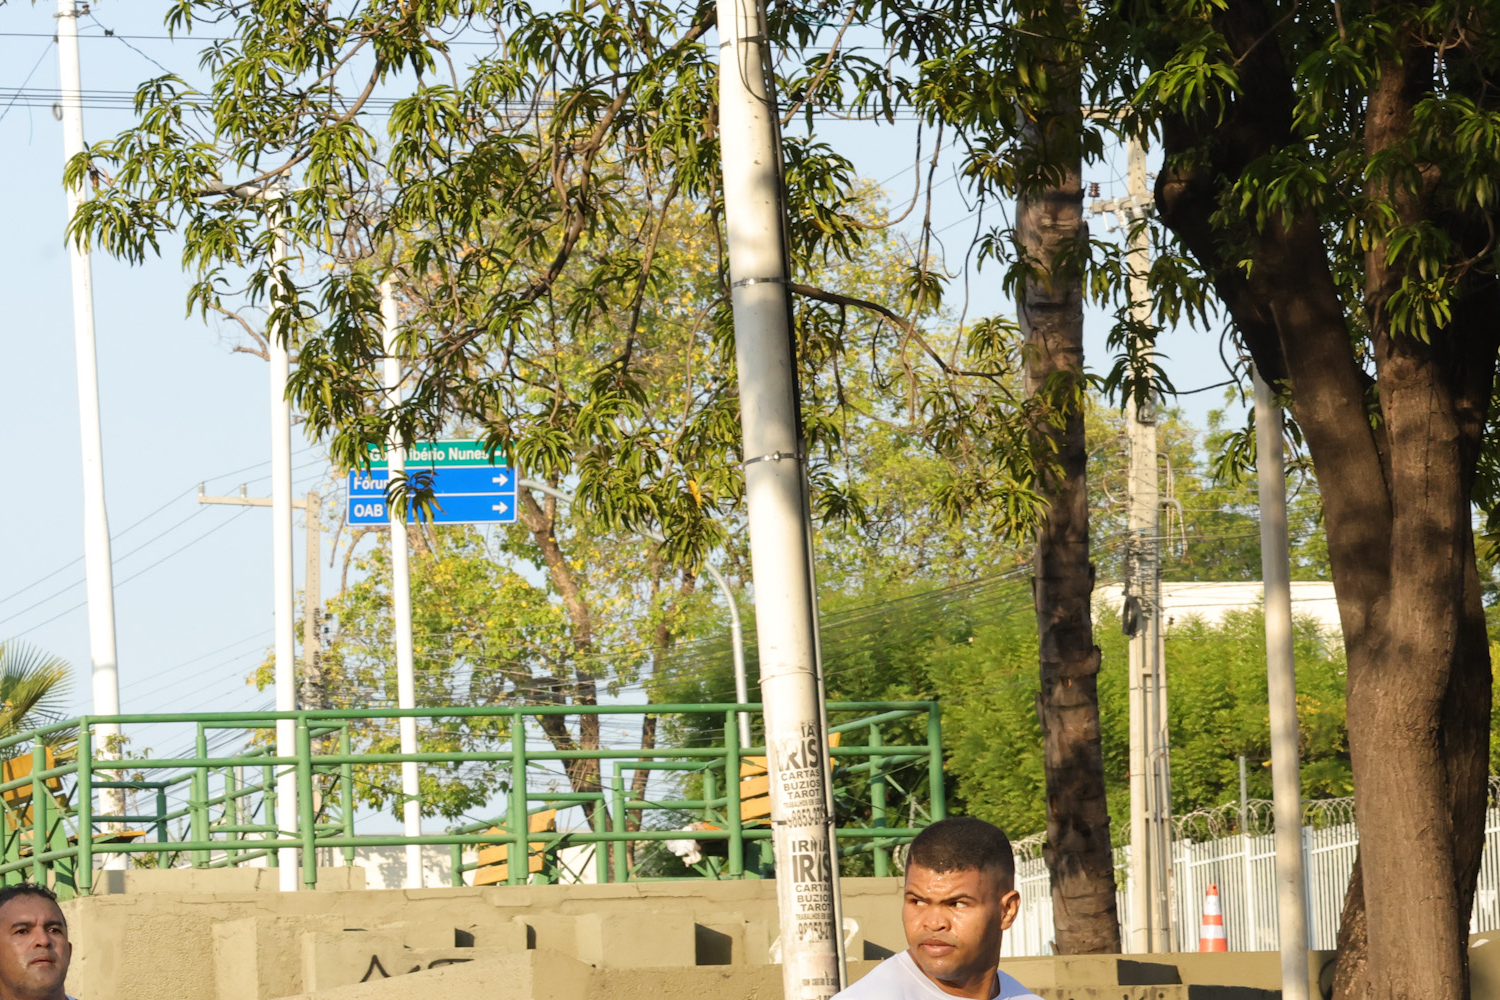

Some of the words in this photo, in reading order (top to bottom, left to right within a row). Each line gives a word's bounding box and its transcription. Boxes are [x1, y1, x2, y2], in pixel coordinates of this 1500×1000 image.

[448, 446, 490, 461] Nunes
[353, 503, 384, 518] OAB
[787, 788, 820, 800] TAROT
